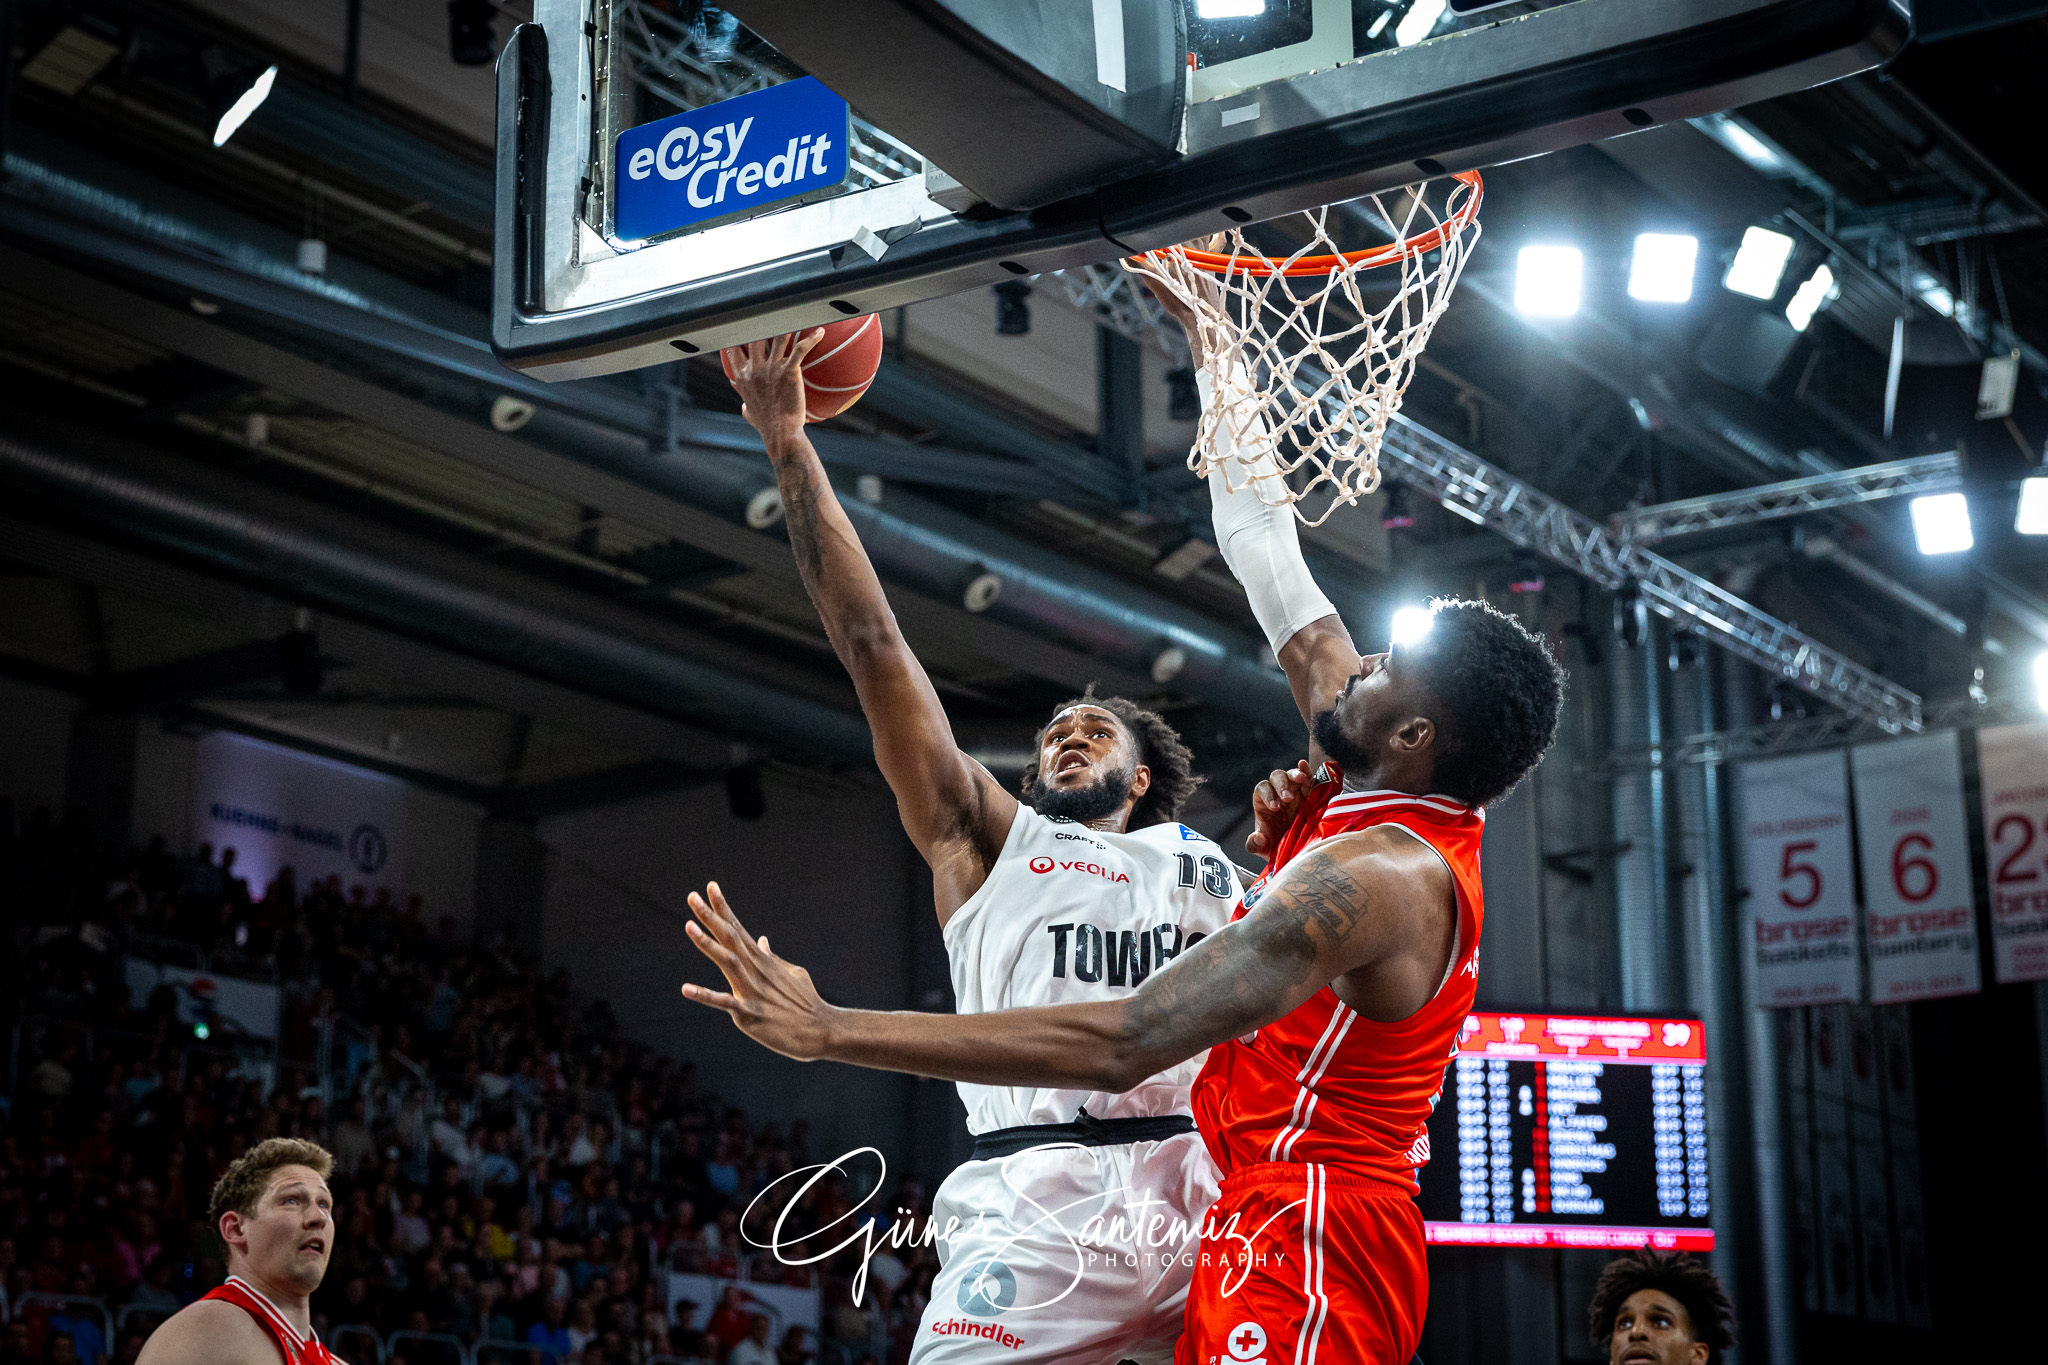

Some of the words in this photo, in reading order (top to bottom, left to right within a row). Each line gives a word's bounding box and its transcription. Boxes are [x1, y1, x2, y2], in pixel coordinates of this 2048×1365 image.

[686, 132, 832, 209] Credit
[1059, 861, 1130, 883] VEOLIA
[1173, 851, 1233, 899] 13
[1777, 839, 1824, 911] 5
[1890, 832, 1940, 904] 6
